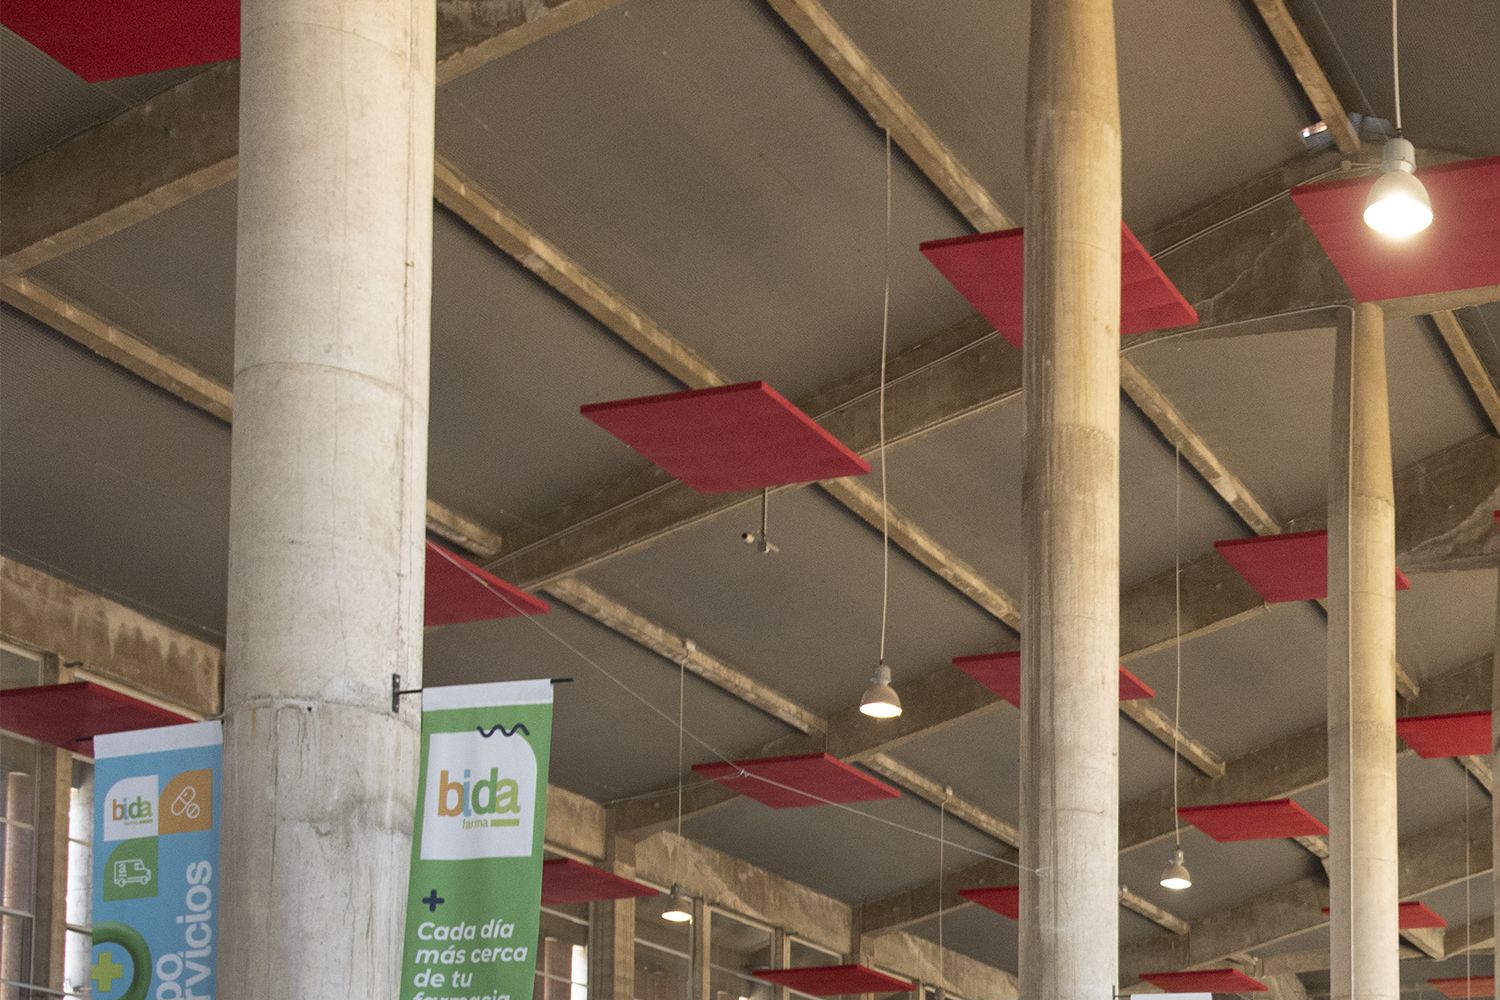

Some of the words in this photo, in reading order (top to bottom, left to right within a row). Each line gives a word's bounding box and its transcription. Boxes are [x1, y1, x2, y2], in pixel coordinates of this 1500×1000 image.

[437, 766, 521, 818] bida
[112, 795, 153, 821] bida
[462, 818, 488, 829] farma
[417, 921, 476, 942] Cada
[480, 918, 515, 939] día
[414, 944, 465, 966] más
[470, 945, 528, 964] cerca
[413, 969, 445, 988] de
[451, 968, 474, 988] tu
